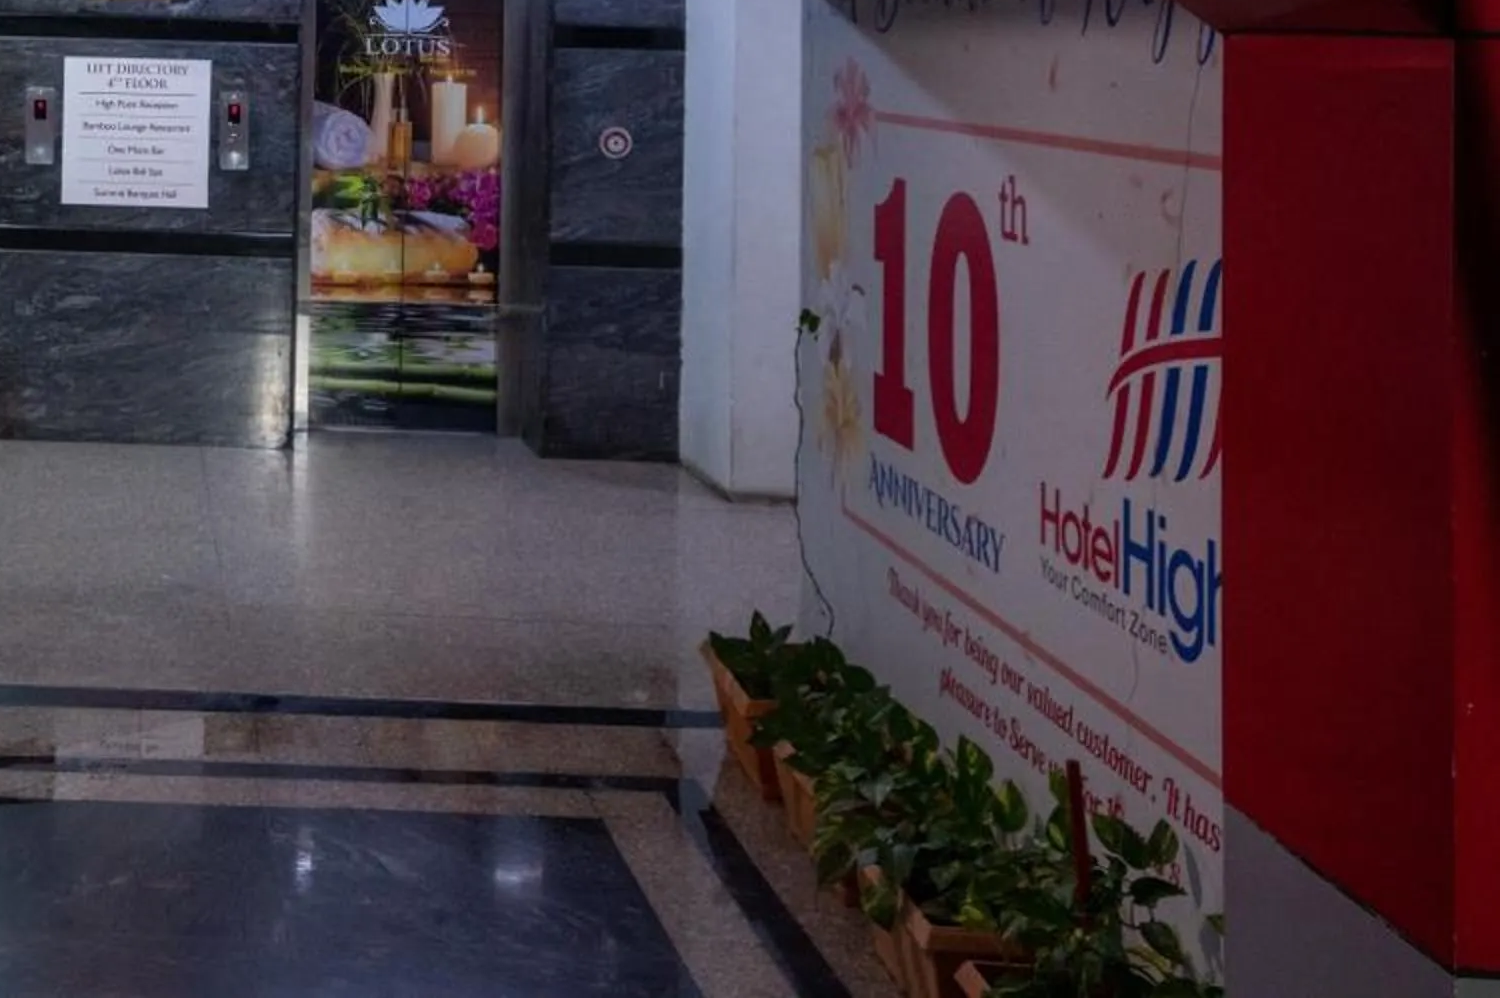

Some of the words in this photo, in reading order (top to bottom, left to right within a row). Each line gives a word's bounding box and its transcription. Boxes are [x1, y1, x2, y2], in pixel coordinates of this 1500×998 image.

[87, 63, 114, 75] LIFT
[117, 63, 190, 76] DIRECTORY
[125, 78, 168, 90] FLOOR
[365, 37, 450, 56] LOTUS
[869, 451, 1005, 573] ANNIVERSARY
[1040, 555, 1068, 592] Your
[1071, 576, 1127, 630] Comfort
[1128, 612, 1168, 654] Zone
[939, 666, 990, 727] pleasure
[991, 706, 1009, 740] to
[1009, 716, 1046, 776] Serve
[942, 610, 963, 647] for
[964, 627, 998, 685] being
[1001, 666, 1025, 695] our
[1027, 682, 1076, 738] valued
[1182, 799, 1222, 853] has
